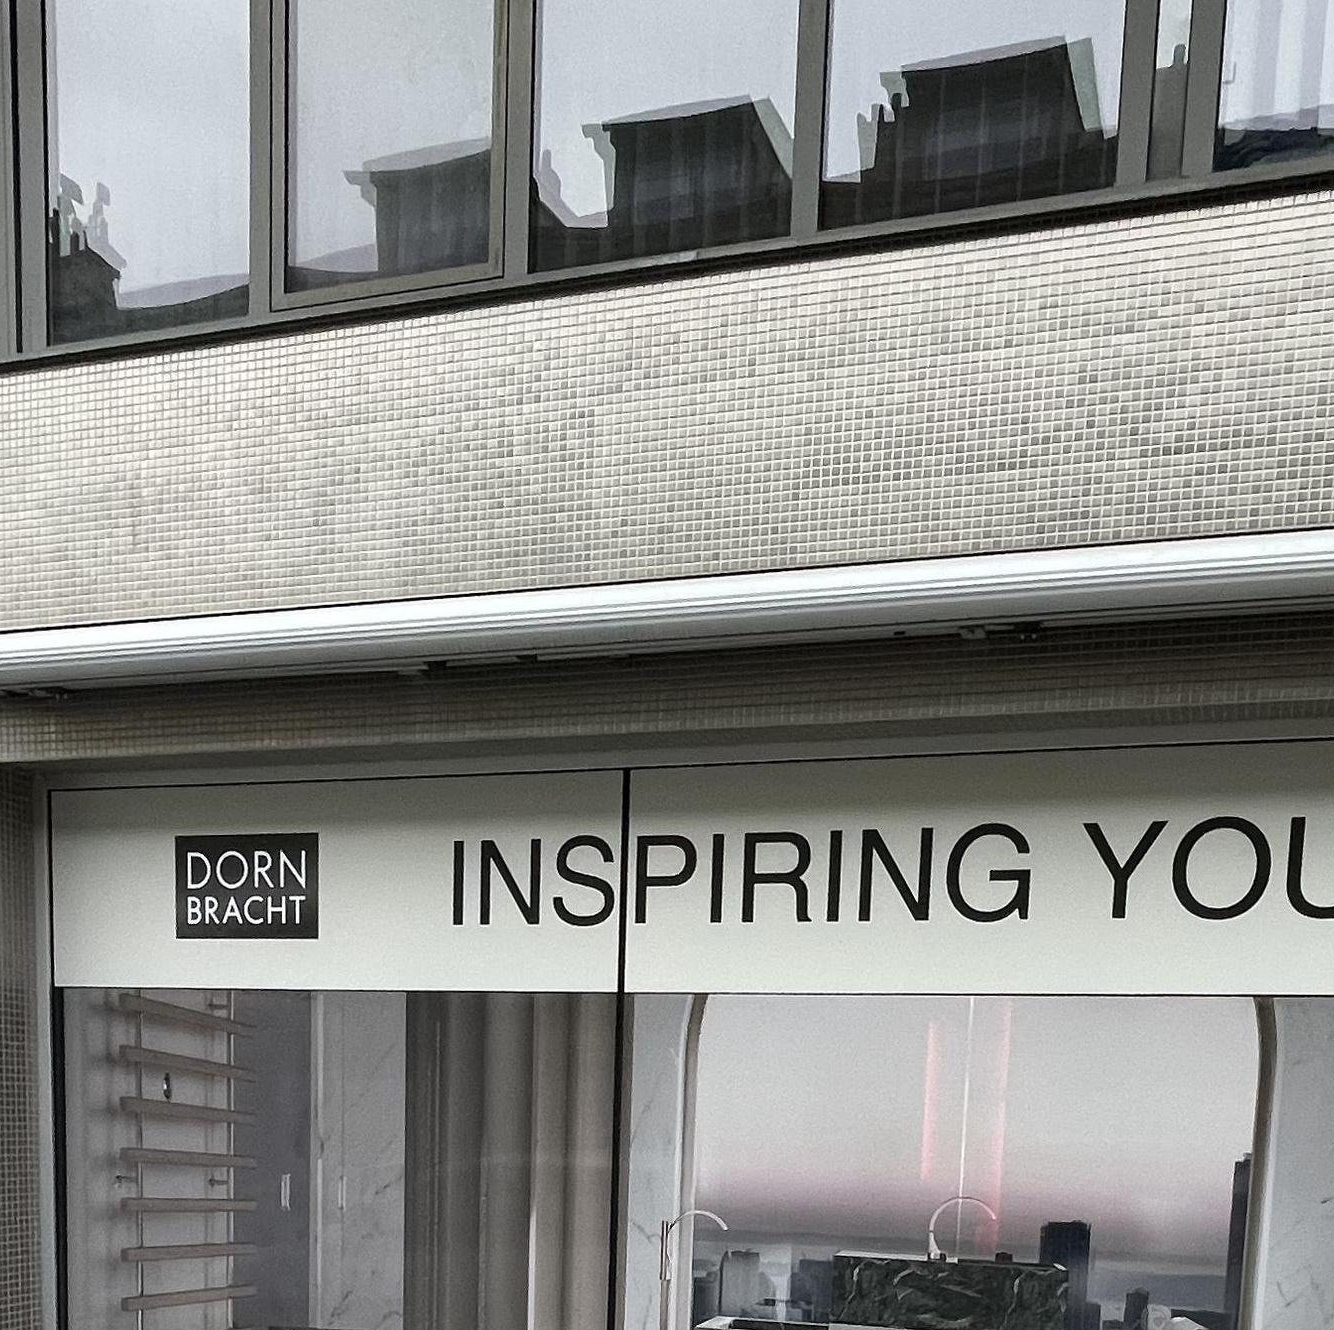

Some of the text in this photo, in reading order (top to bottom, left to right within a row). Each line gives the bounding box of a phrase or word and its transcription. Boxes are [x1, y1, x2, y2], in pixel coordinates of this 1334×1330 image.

[187, 849, 307, 890] DORN
[453, 825, 1031, 926] INSPIRING
[187, 895, 307, 926] BRACHT
